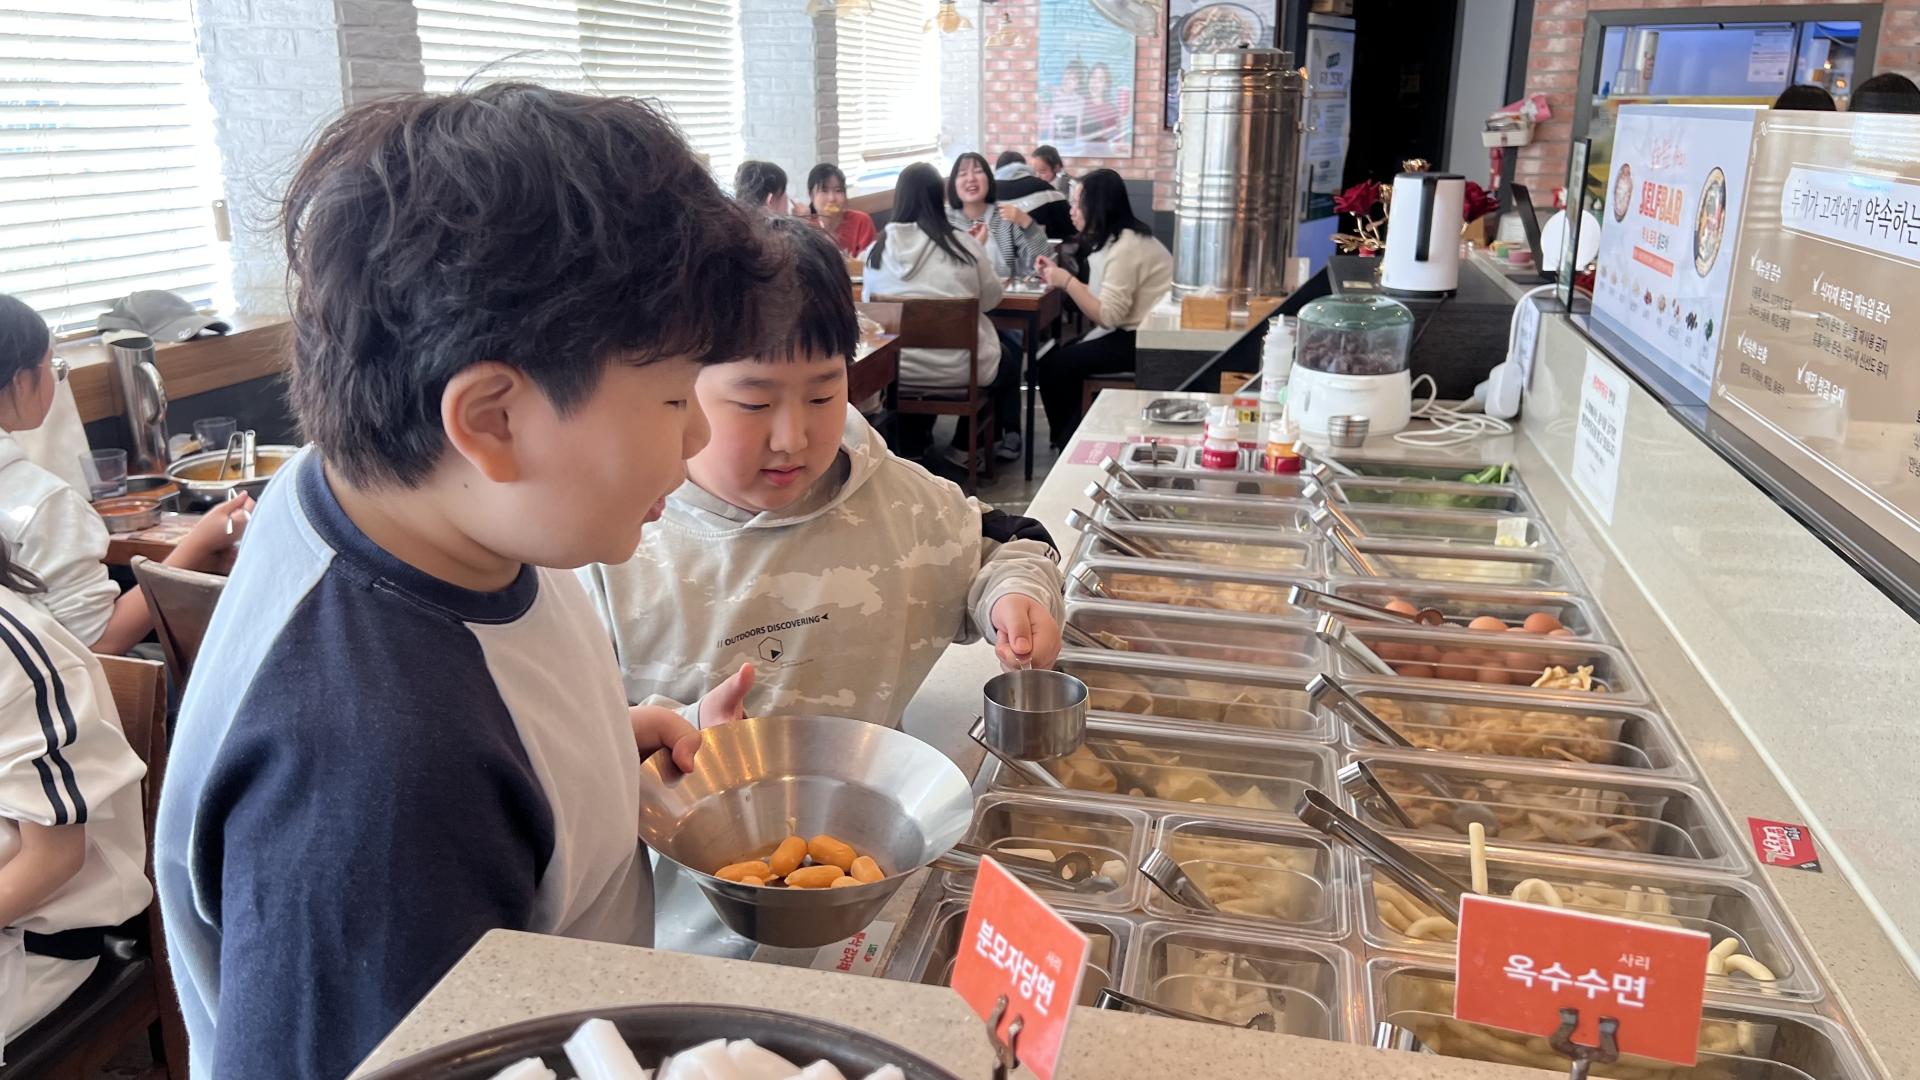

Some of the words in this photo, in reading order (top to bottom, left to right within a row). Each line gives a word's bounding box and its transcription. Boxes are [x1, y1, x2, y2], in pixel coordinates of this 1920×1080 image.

[1819, 196, 1862, 230] 고객에게
[1865, 196, 1920, 245] 약속하는
[1771, 263, 1782, 283] 준수
[1820, 282, 1840, 306] 식자재
[1840, 288, 1853, 311] 취급
[1854, 294, 1875, 319] 매뉴얼
[1875, 303, 1891, 325] 준수
[1817, 376, 1831, 400] 청결
[1831, 385, 1846, 408] 유지
[724, 626, 766, 646] OUTDOORS
[767, 615, 821, 633] DISCOVERING
[976, 918, 1056, 1016] 분모자당면
[1618, 952, 1651, 971] 사리
[1503, 954, 1647, 1008] 옥수수면
